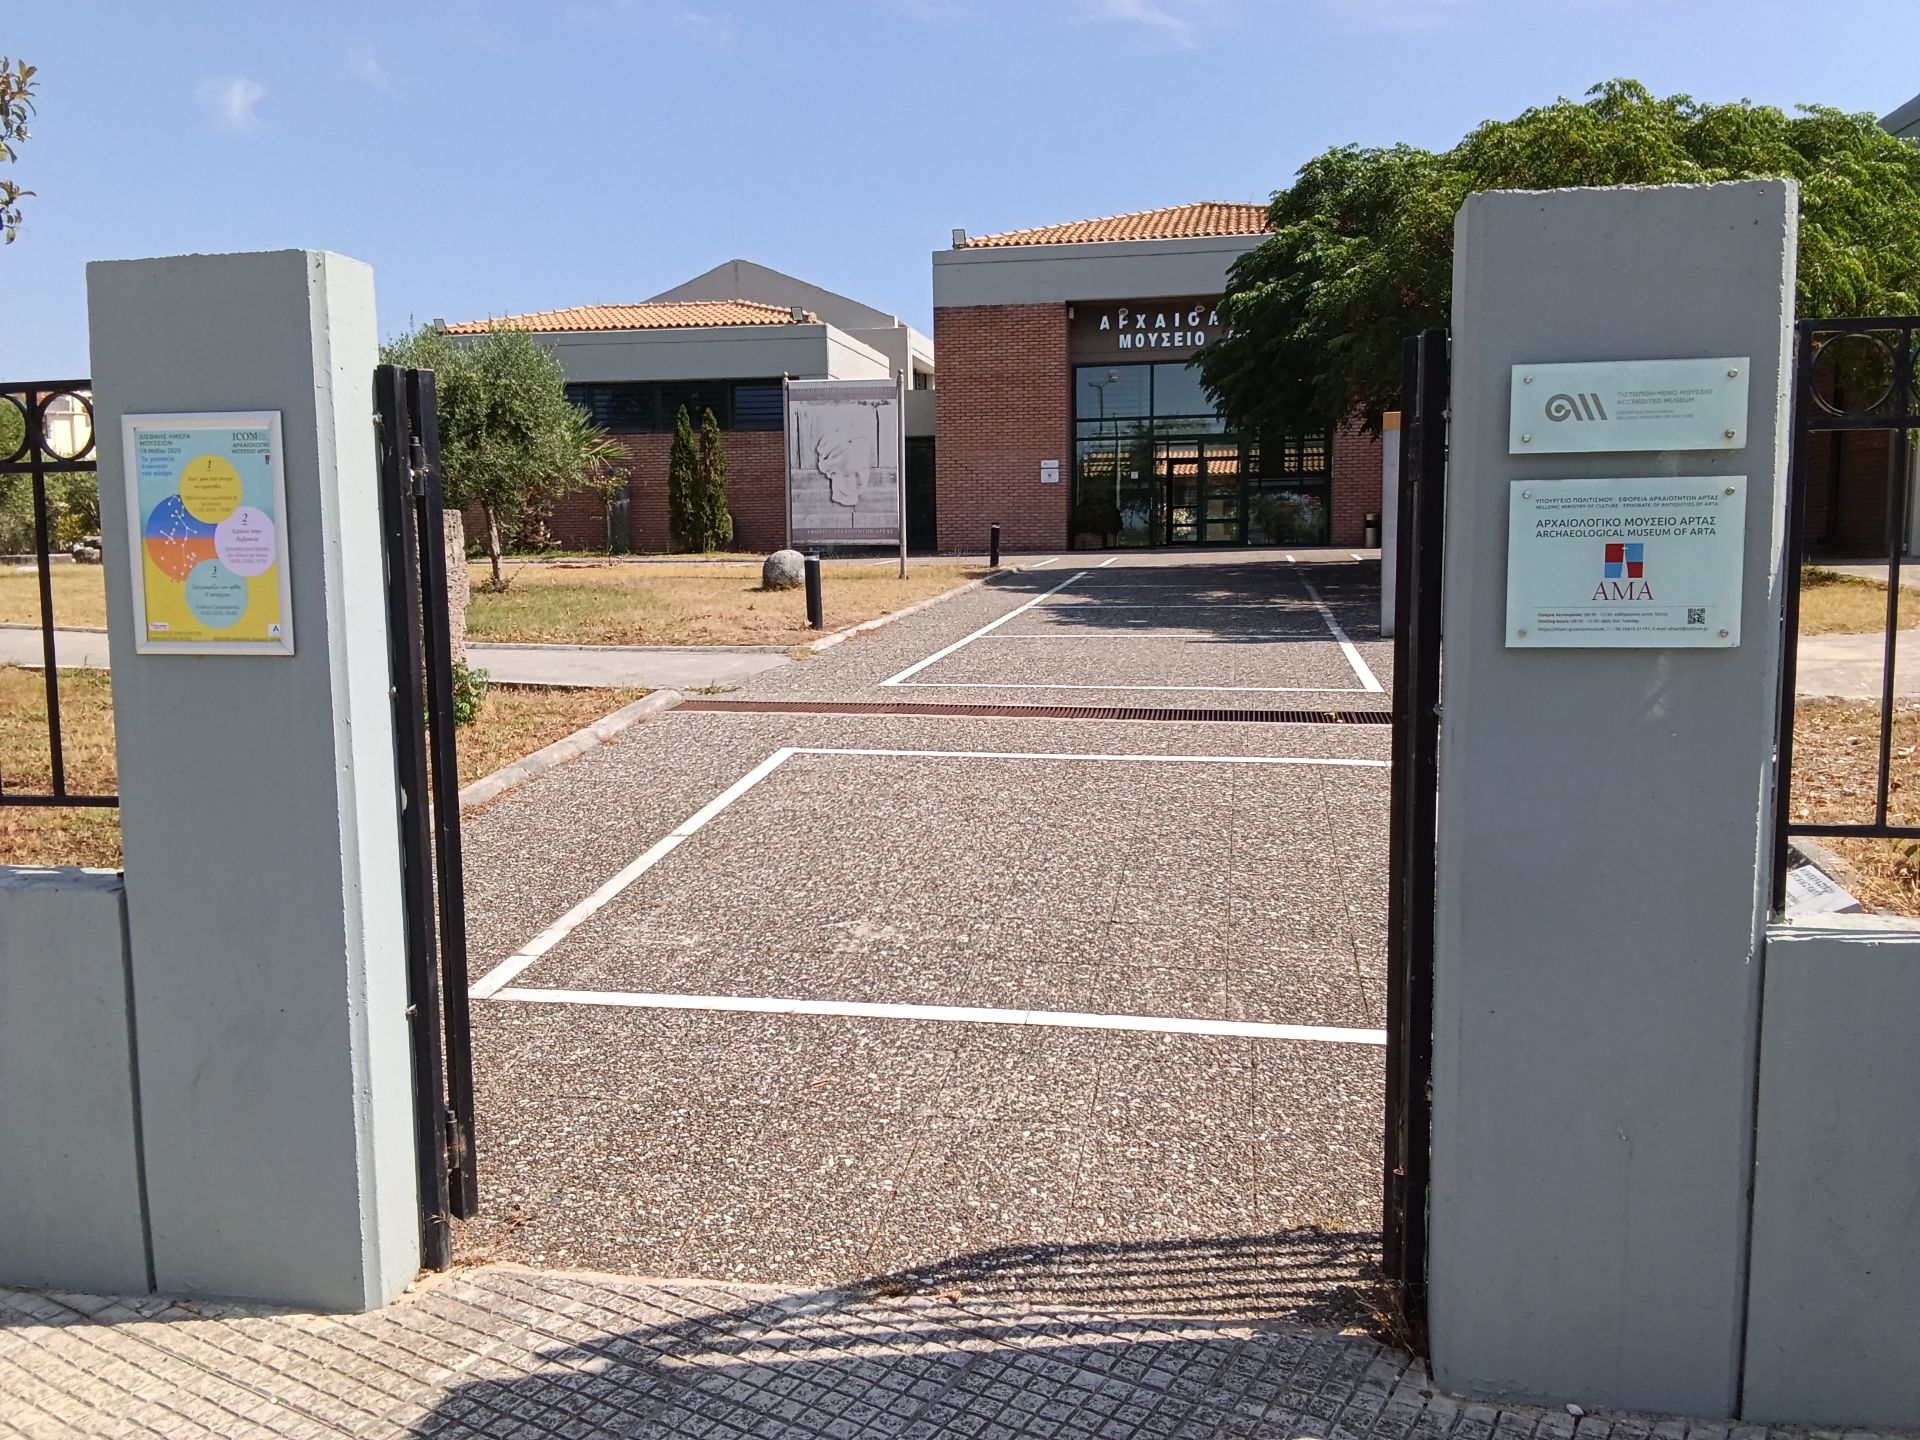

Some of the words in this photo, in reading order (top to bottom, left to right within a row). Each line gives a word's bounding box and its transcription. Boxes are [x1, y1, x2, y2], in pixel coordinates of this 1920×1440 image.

[1119, 331, 1205, 349] ΜΟΥΣΕΙΟ
[232, 432, 258, 441] ICOM
[242, 513, 248, 523] 2
[1536, 518, 1621, 528] ΑΡΧΑΙΟΛΟΓΙΚΟ
[1624, 516, 1677, 527] ΜΟΥΣΕΙΟ
[1679, 516, 1717, 526] ΑΡΤΑΣ
[1536, 529, 1625, 538] ARCHAEOLOGICAL
[1627, 528, 1671, 537] MUSEUM
[1673, 527, 1687, 536] OF
[1689, 527, 1716, 536] ARTA
[211, 565, 217, 576] 3
[1591, 581, 1654, 600] AMA
